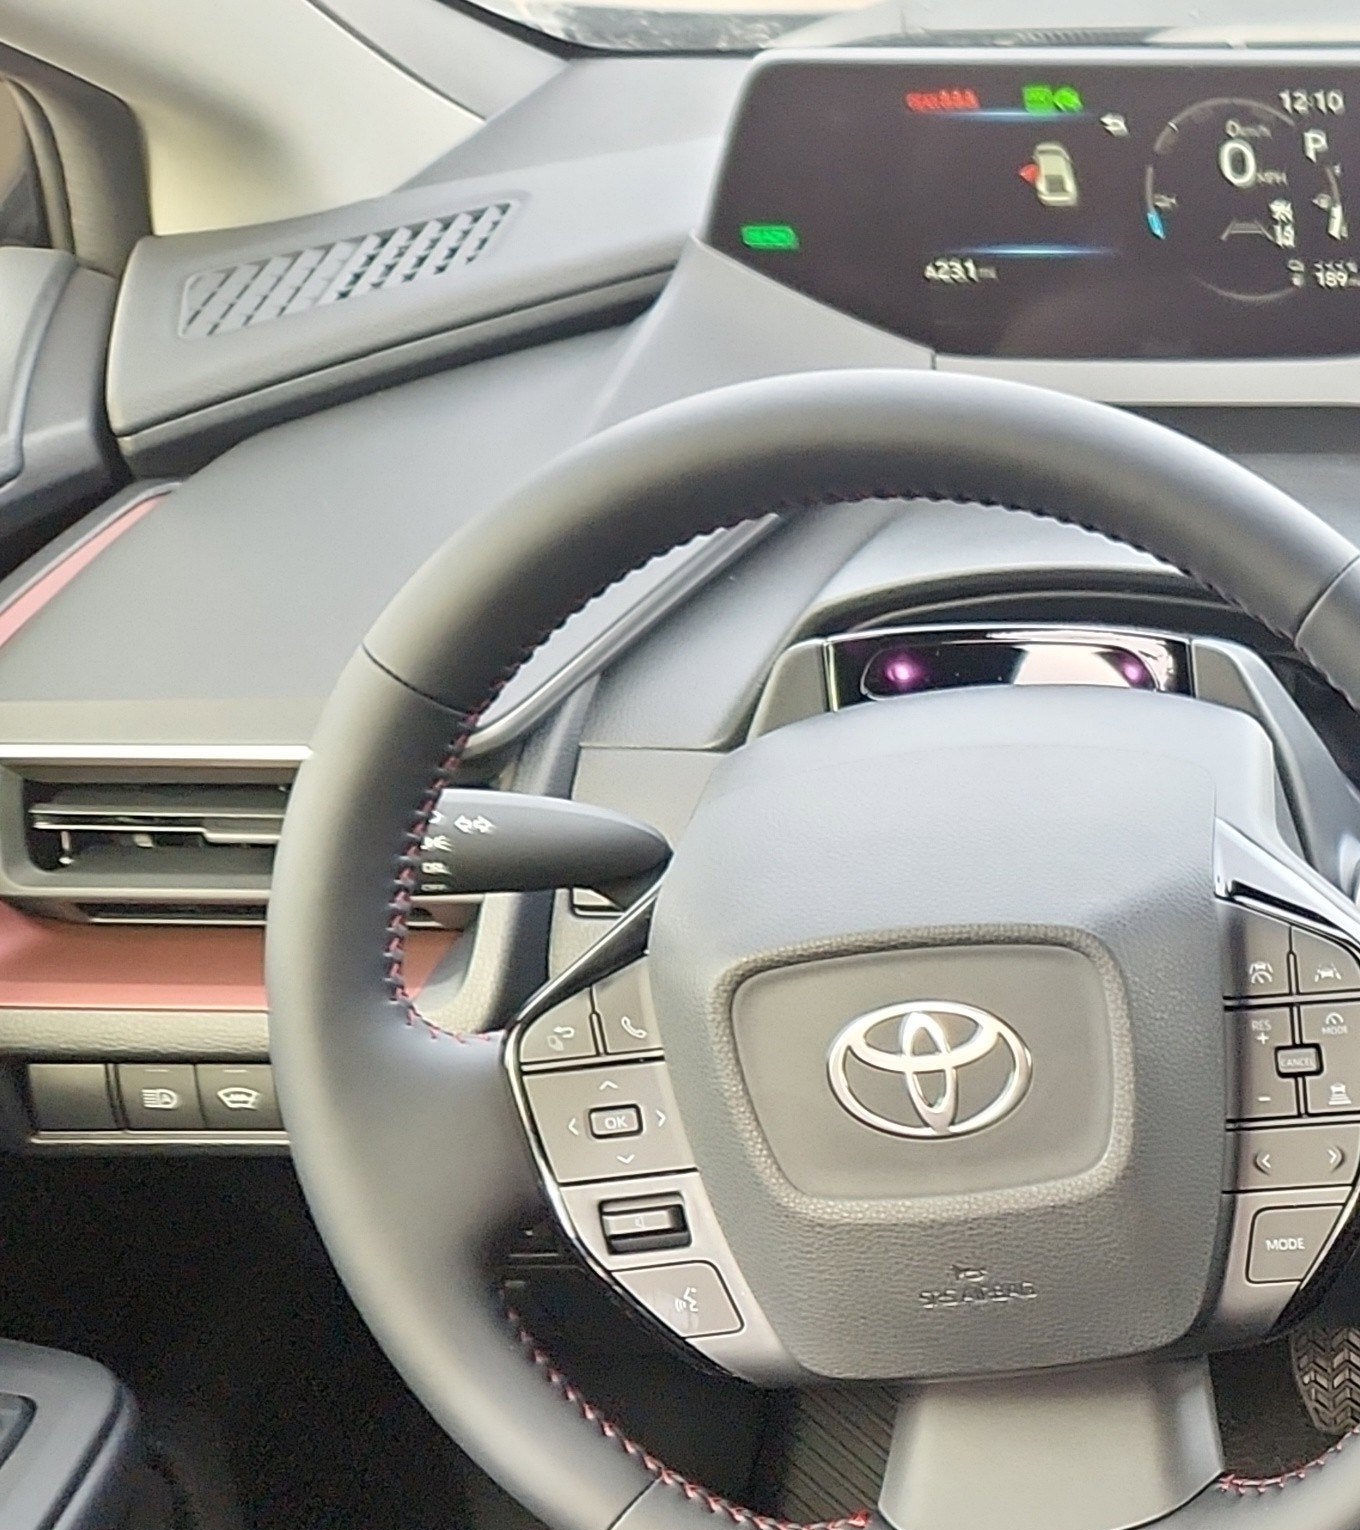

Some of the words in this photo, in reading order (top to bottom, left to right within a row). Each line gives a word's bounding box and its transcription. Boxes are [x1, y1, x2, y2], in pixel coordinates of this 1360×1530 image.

[1303, 128, 1329, 164] P
[1219, 139, 1257, 188] 0
[604, 1115, 629, 1131] OK
[1265, 1237, 1306, 1252] MODE
